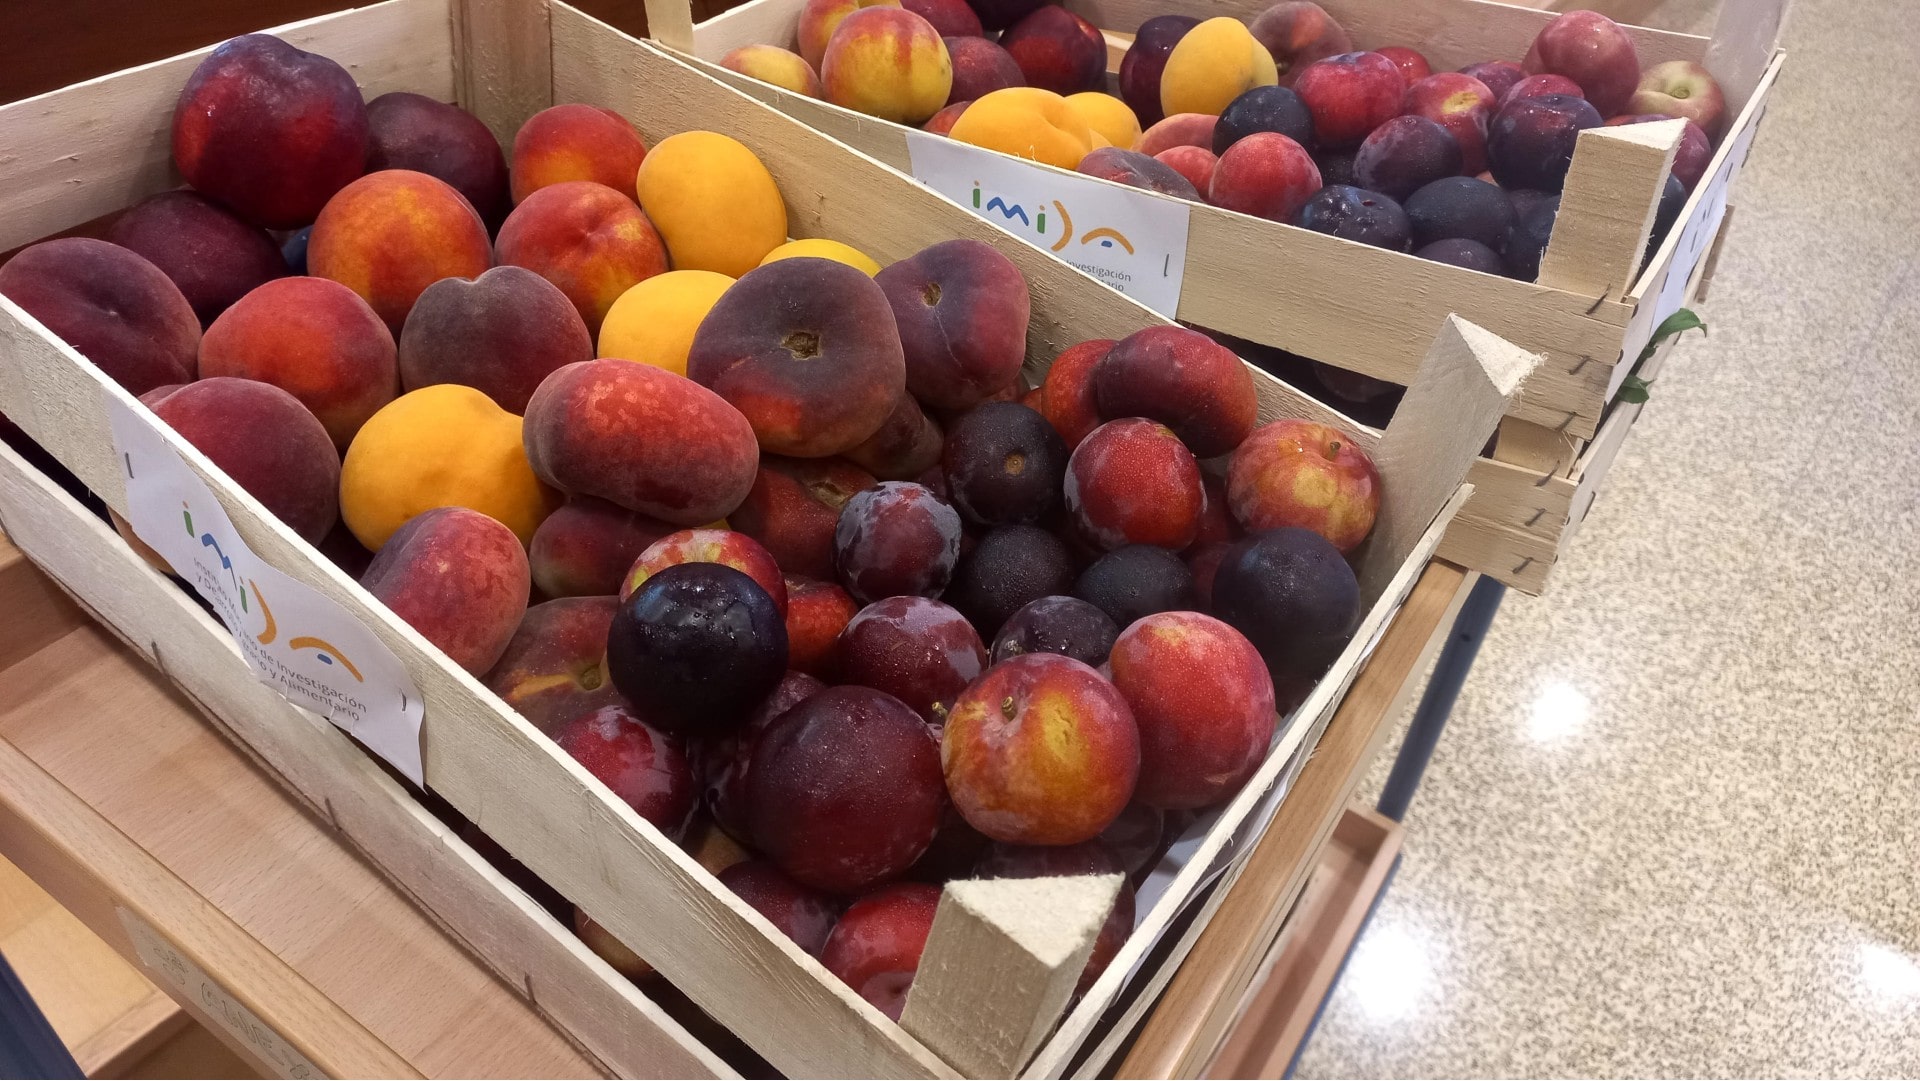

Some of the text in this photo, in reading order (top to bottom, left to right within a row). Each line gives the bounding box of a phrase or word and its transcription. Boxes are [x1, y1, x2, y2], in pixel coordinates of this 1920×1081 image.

[260, 649, 275, 665] de
[277, 660, 367, 714] Investigación
[280, 675, 360, 721] Alimentario
